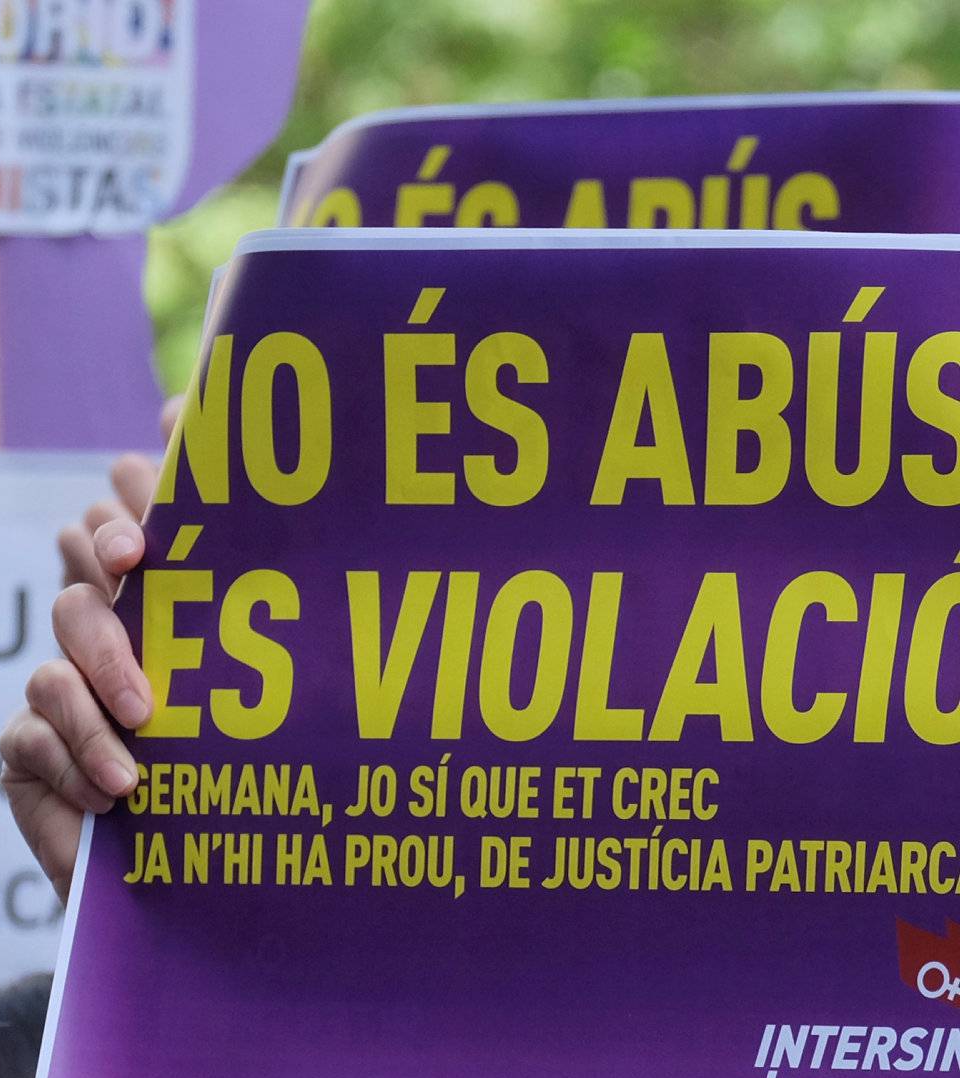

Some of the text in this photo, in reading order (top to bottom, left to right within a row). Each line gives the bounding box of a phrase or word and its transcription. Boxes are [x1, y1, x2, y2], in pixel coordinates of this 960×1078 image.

[152, 287, 960, 506] NO ÉS ABÚS
[135, 525, 960, 745] ÉS VIOLACIÓ
[123, 832, 172, 884] JA
[346, 835, 464, 896] PROU,
[481, 836, 531, 888] DE
[543, 826, 732, 891] JUSTÍCIA
[746, 839, 960, 894] PATRIARC
[128, 753, 719, 827] GERMANA, JO SÍ QUE ET CREC
